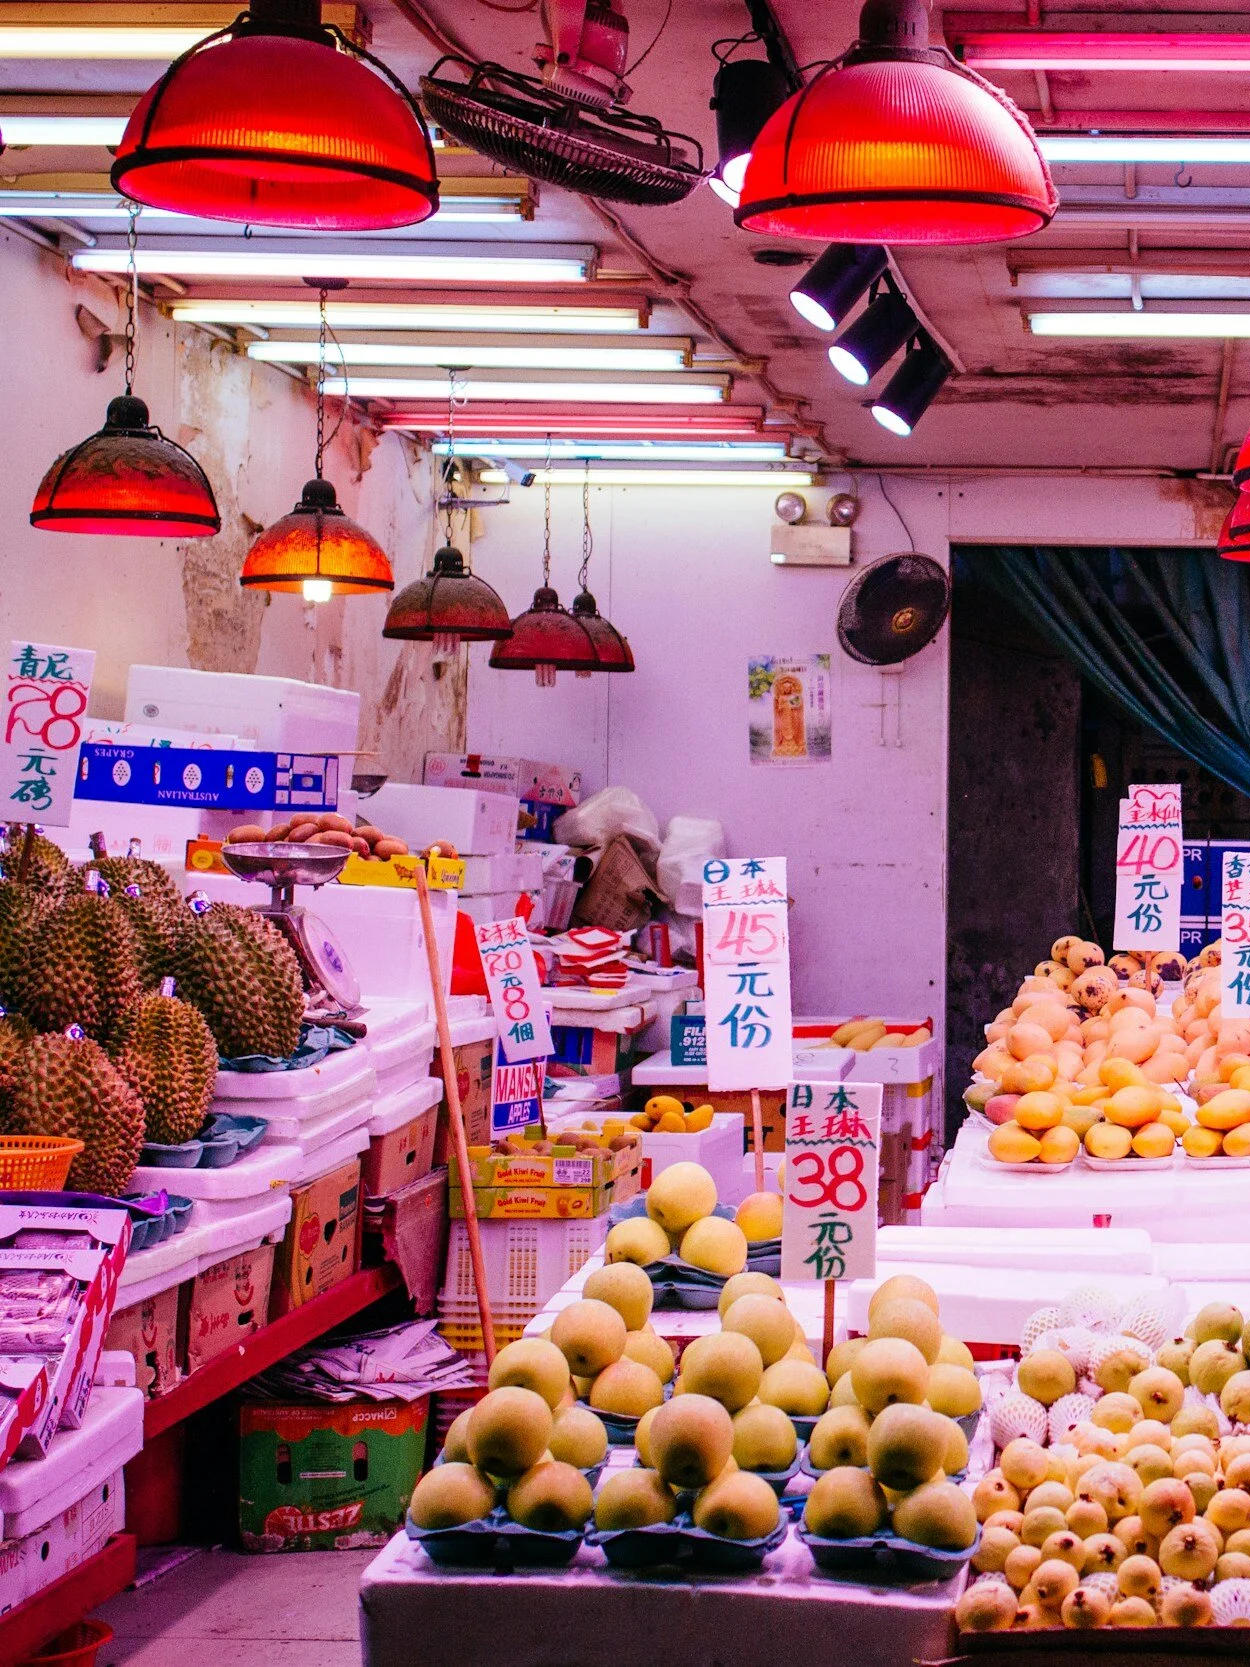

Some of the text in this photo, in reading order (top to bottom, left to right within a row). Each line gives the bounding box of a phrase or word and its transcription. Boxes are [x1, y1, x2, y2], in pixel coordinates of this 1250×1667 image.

[5, 684, 87, 750] 28
[95, 748, 135, 758] GRAPES
[158, 790, 220, 802] AUSTRALIAN
[1116, 834, 1180, 875] 40
[703, 859, 766, 884] 日本
[716, 910, 778, 956] 45
[485, 950, 523, 977] 20
[500, 972, 523, 988] 元
[502, 986, 530, 1021] 8
[507, 1022, 534, 1044] 個
[684, 1026, 706, 1037] FIL
[791, 1083, 860, 1114] 日本
[507, 1101, 532, 1124] APPLES
[497, 1167, 545, 1179] Gold Kiwi Fruit
[789, 1145, 868, 1212] 38
[497, 1196, 546, 1208] Gold Kiwi Fruit
